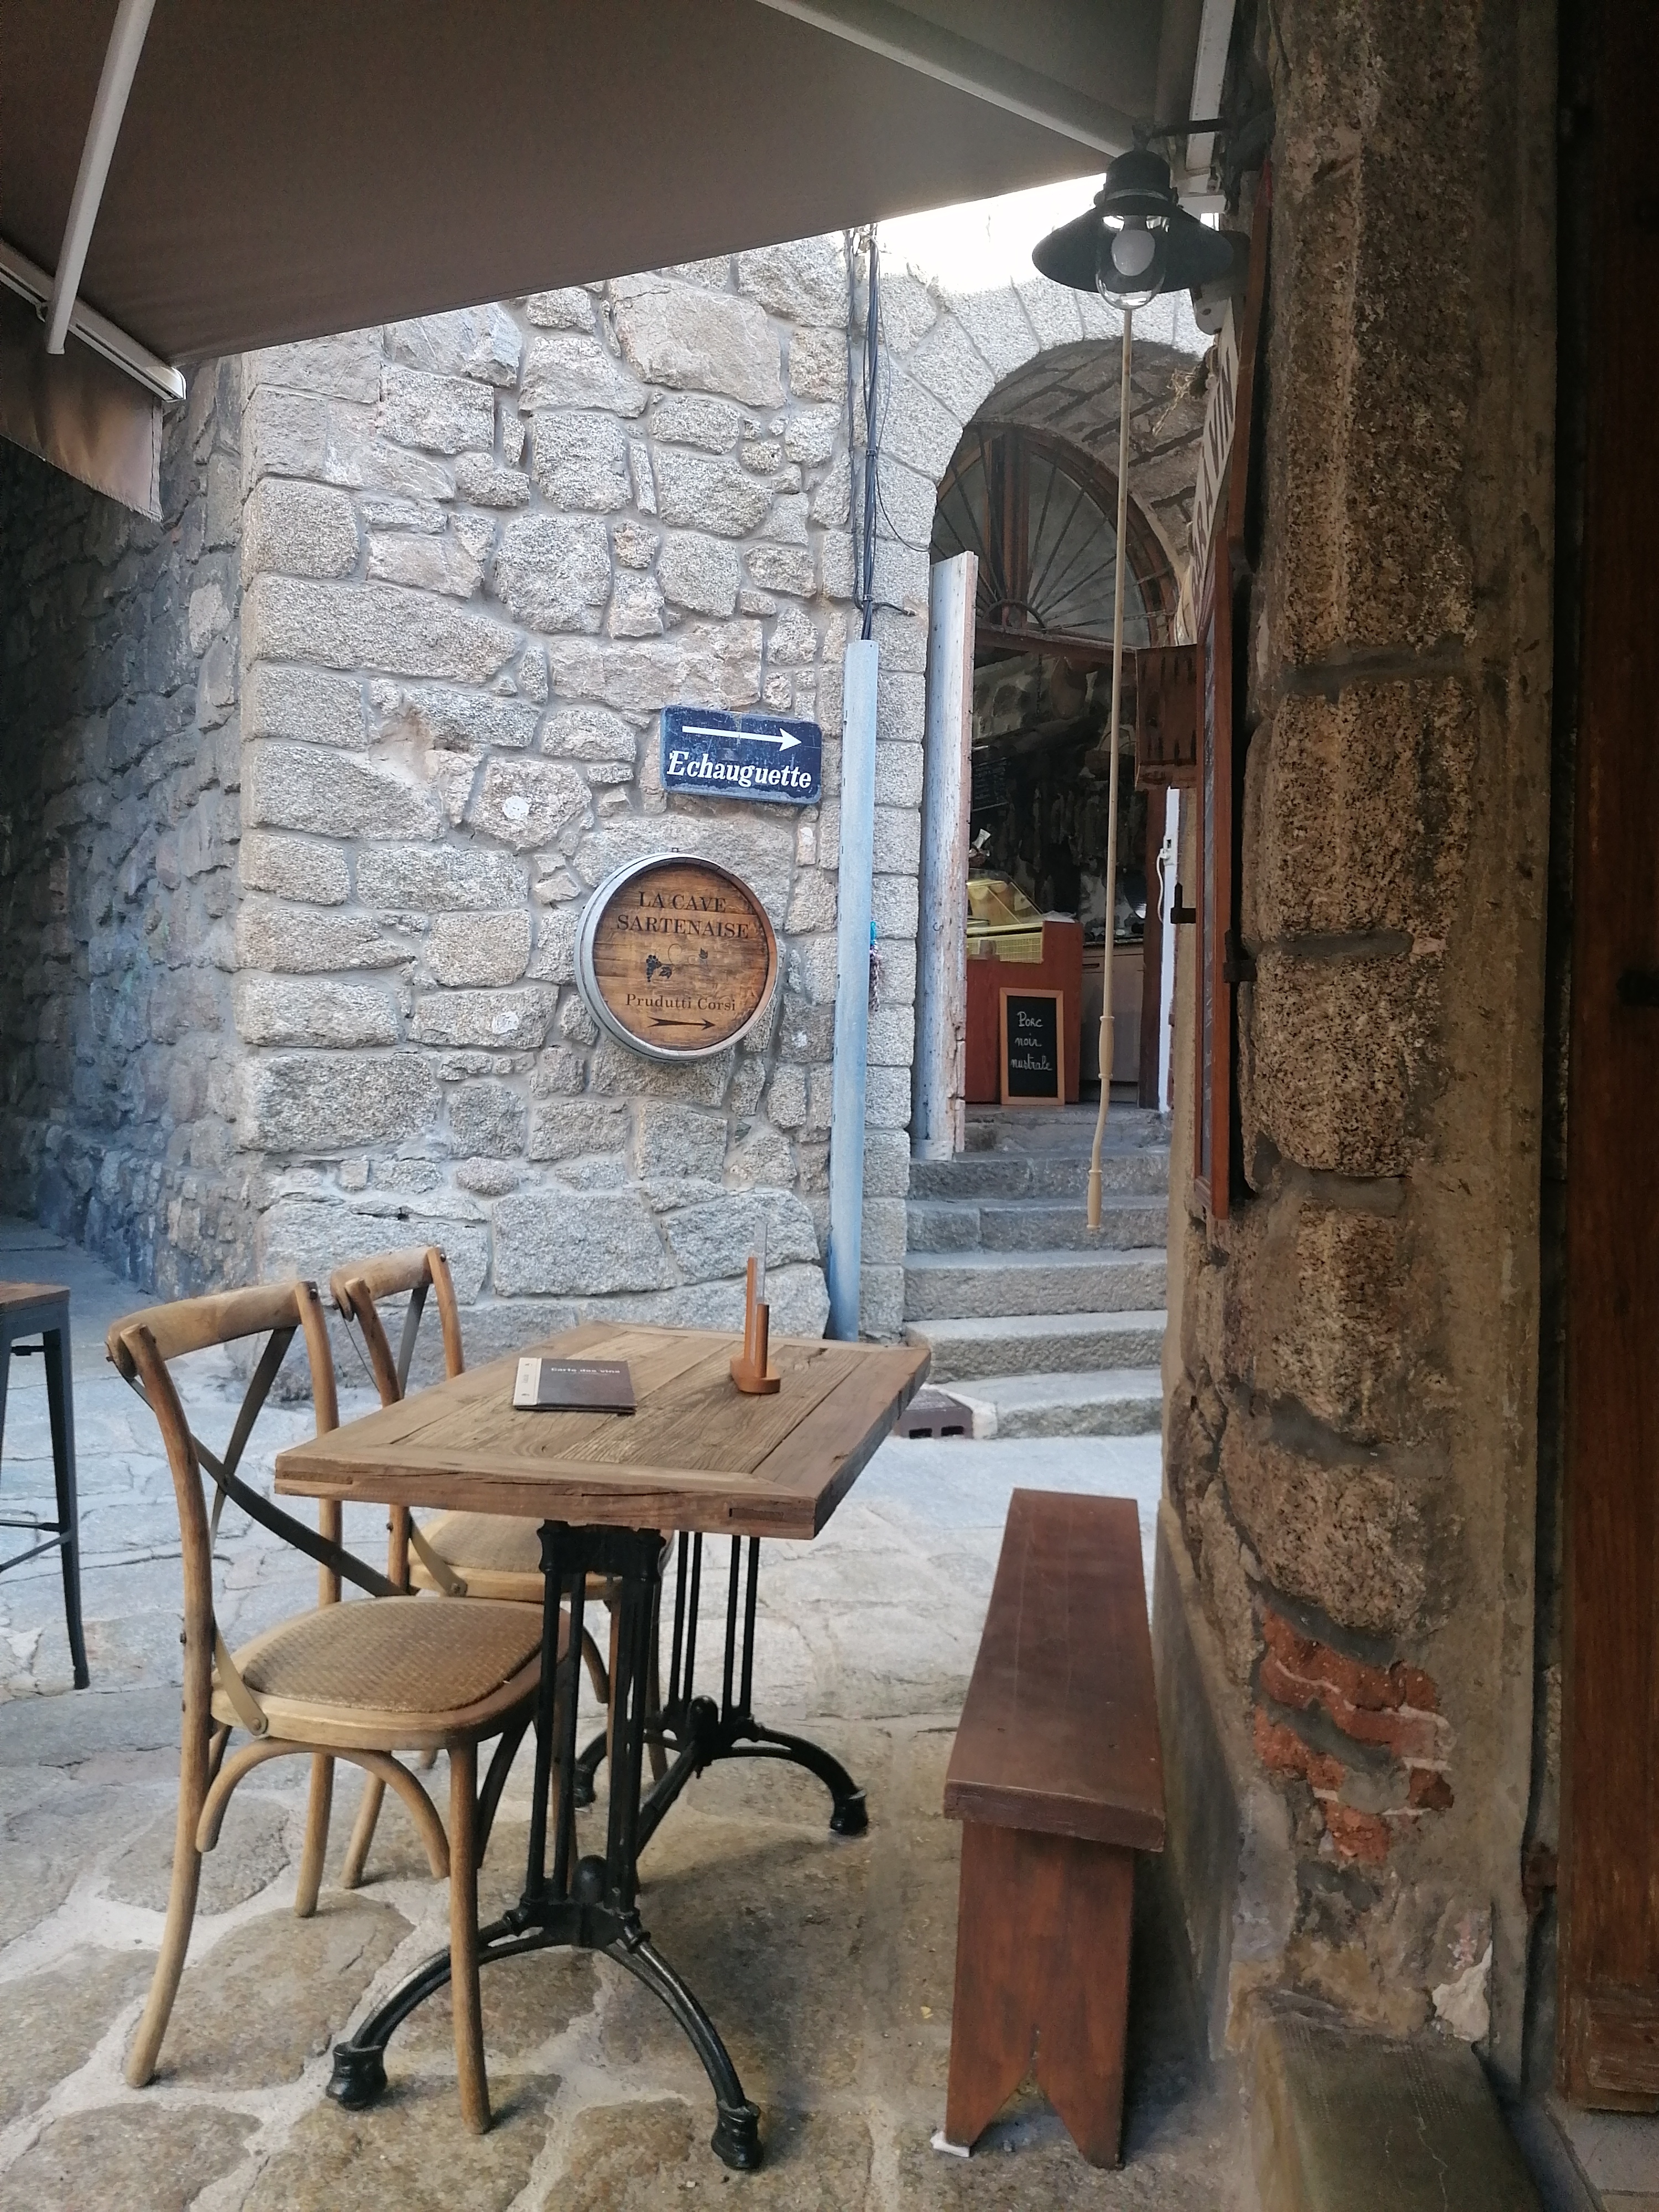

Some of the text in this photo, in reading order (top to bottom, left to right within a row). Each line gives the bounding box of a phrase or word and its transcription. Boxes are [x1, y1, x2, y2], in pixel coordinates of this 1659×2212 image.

[1209, 347, 1234, 480] VIN
[638, 891, 726, 912] LA CAVE
[617, 915, 749, 938] SARTENAISE
[626, 993, 735, 1011] Prudutti Corsi
[1014, 1032, 1043, 1047] noir
